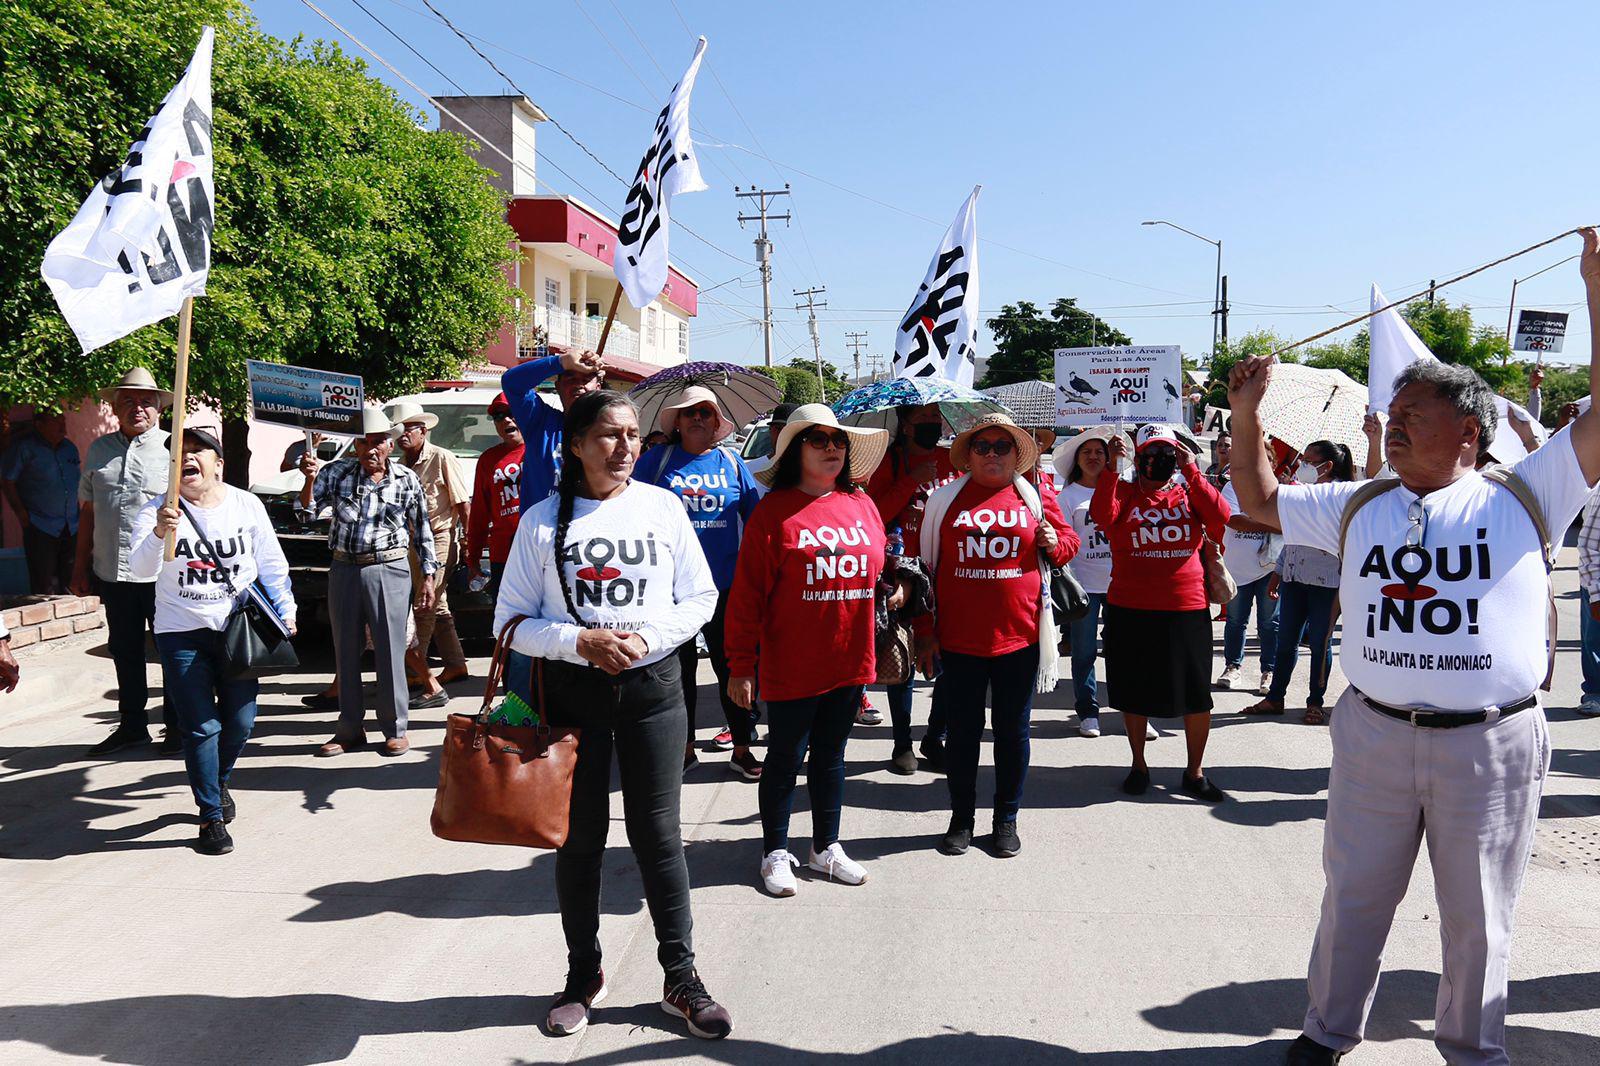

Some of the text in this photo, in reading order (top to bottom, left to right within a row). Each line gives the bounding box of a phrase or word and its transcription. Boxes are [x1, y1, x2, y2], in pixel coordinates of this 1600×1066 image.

[322, 384, 359, 397] AQUÍ
[1110, 375, 1149, 391] AQUÍ
[267, 402, 275, 411] LA
[277, 404, 302, 416] PLANTA
[304, 410, 313, 418] DE
[325, 397, 357, 408] ¡NO!
[1112, 391, 1146, 405] ¡NO!
[670, 468, 728, 493] AQUÍ
[953, 506, 1028, 534] AQUÍ
[175, 527, 246, 560] AQUÍ
[797, 520, 871, 553] AQUÍ
[1131, 524, 1190, 548] ¡NO!
[957, 536, 1020, 562] ¡NO!
[1163, 550, 1170, 558] DE
[1360, 528, 1491, 590] AQUÍ
[178, 564, 240, 588] ¡NO!
[806, 554, 868, 585] ¡NO!
[959, 568, 965, 578] LA
[966, 568, 987, 579] PLANTA
[988, 569, 996, 579] DE
[996, 567, 1023, 579] AMONIACO
[802, 588, 874, 601] A LA PLANTA DE AMONIACO
[1366, 597, 1480, 638] ¡NO!
[1363, 645, 1492, 671] A LA PLANTA DE AMONIACO
